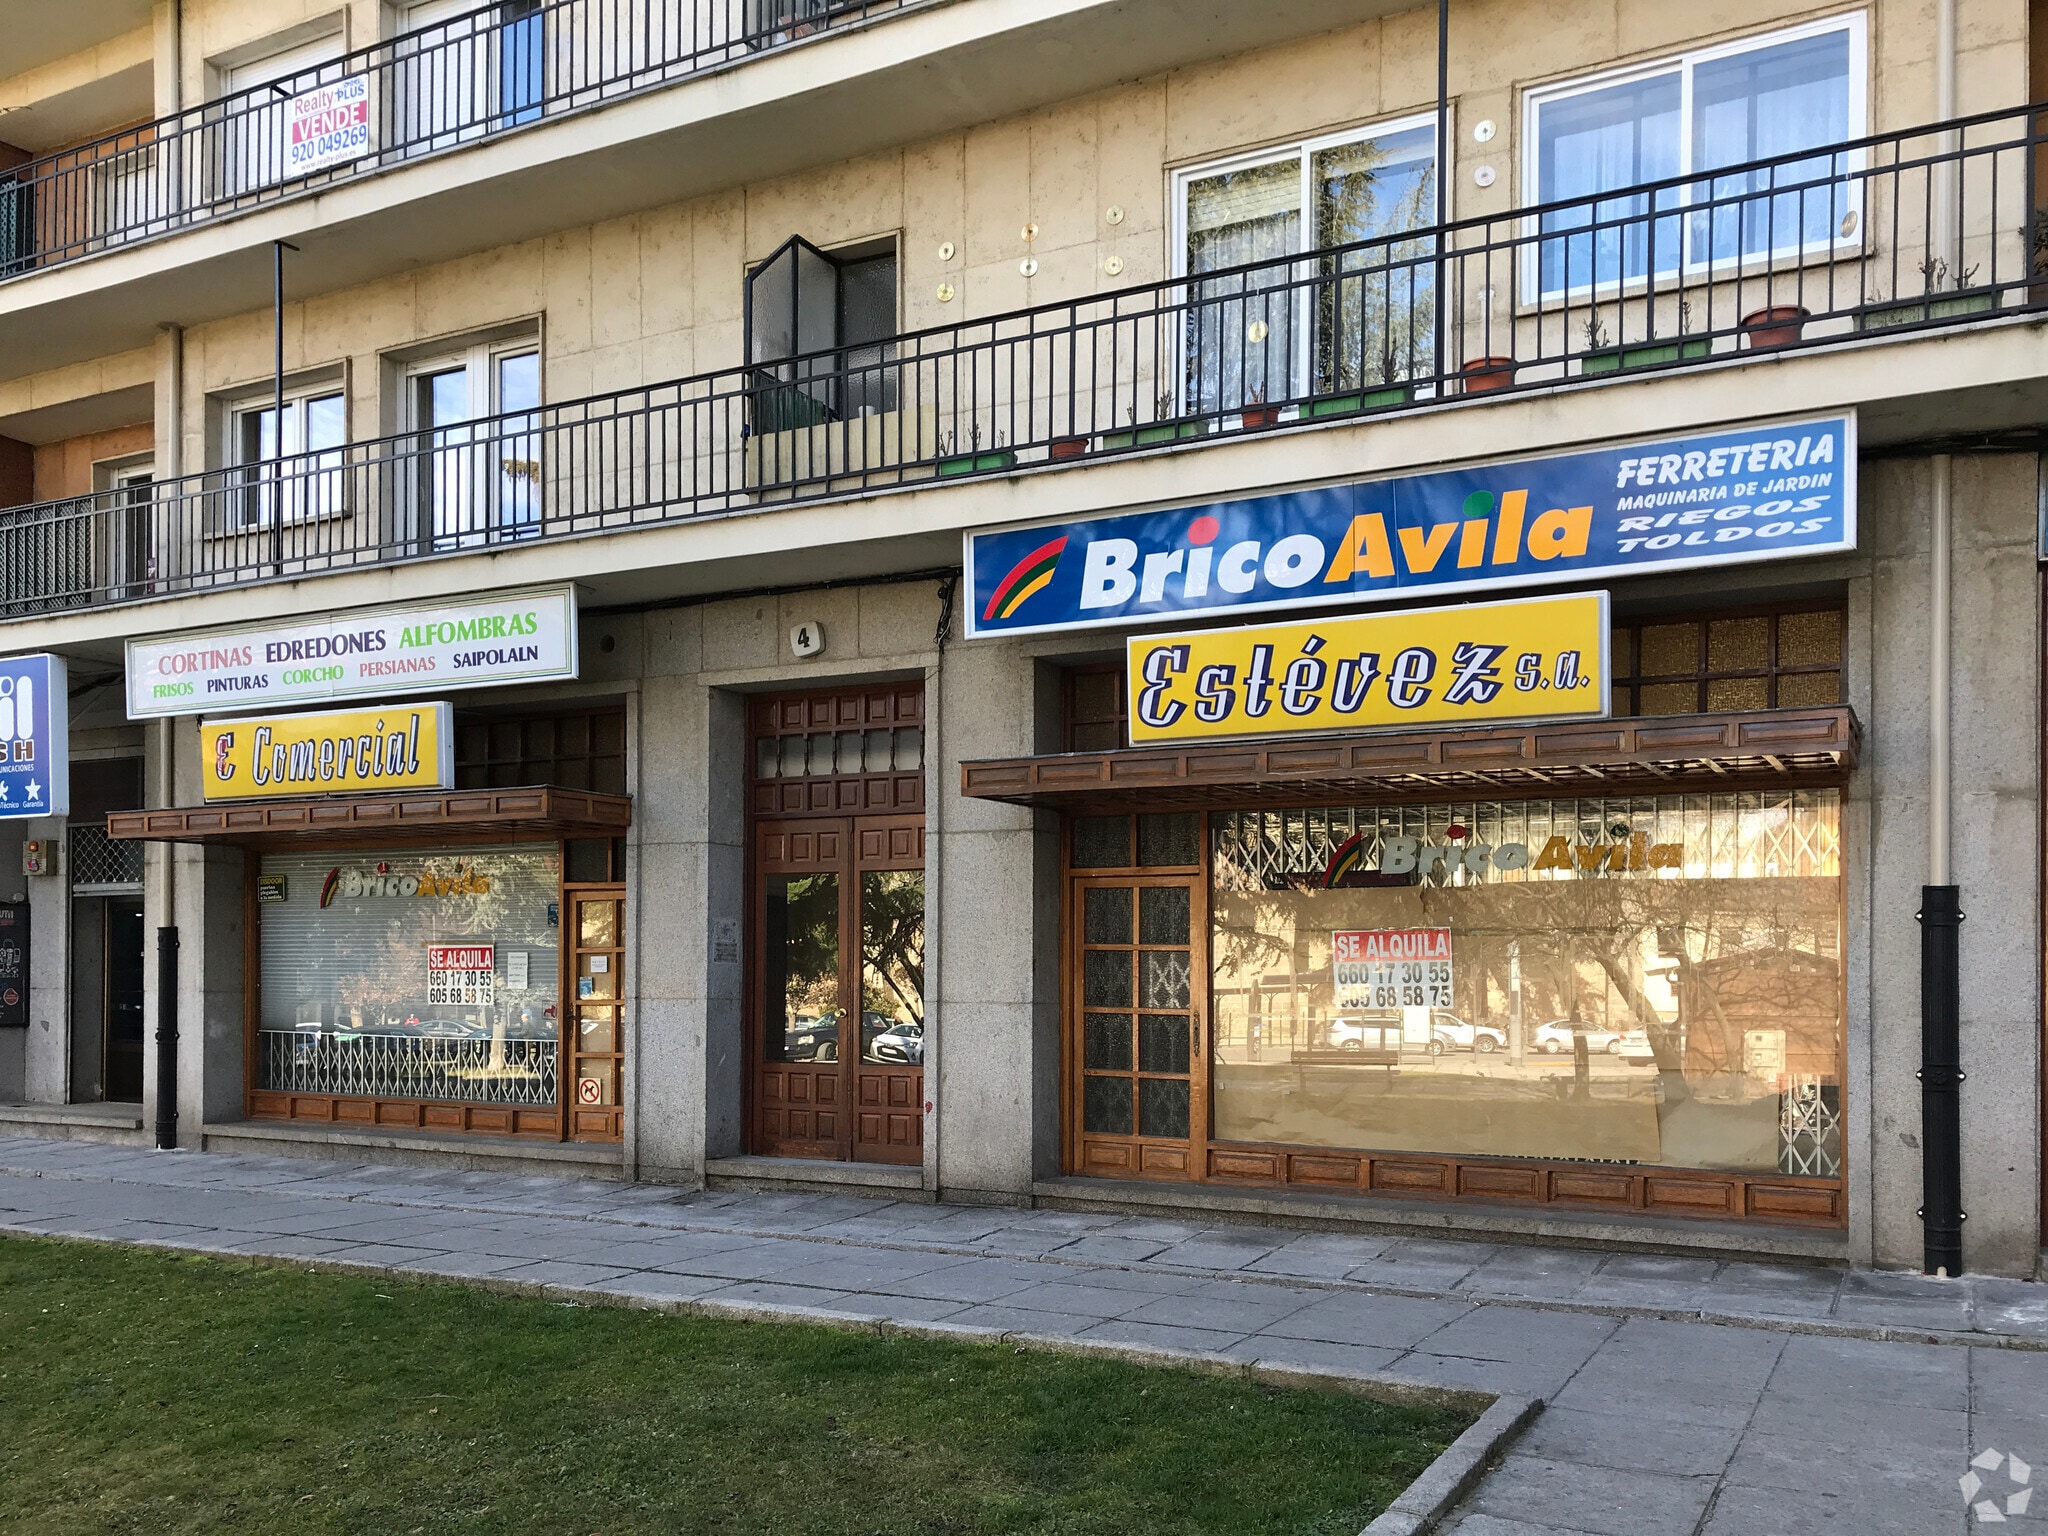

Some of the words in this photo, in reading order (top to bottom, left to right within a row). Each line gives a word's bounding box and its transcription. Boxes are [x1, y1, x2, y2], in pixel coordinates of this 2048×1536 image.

[295, 90, 334, 117] Realty
[298, 102, 360, 141] VENDE
[292, 140, 315, 165] 920
[317, 124, 367, 155] 049269
[1617, 433, 1834, 488] FERRETERIA
[1617, 485, 1728, 511] MAQUINARIA
[1734, 481, 1758, 497] DE
[1762, 473, 1833, 494] JARDIN
[1617, 495, 1832, 532] RIEGOS
[1080, 489, 1594, 610] BricoAvila
[1617, 517, 1833, 553] TOLDOS
[158, 645, 253, 676] CORTINAS
[266, 629, 387, 663] EDREDONES
[399, 612, 538, 649] ALFOMBRAS
[797, 627, 810, 648] 4
[153, 682, 195, 699] FRISOS
[207, 674, 269, 693] PINTURAS
[282, 665, 345, 685] CORCHO
[359, 656, 436, 678] PERSIANAS
[453, 645, 539, 669] SAIPOLALN
[1137, 634, 1508, 728] Estévez
[252, 713, 420, 786] Comercial
[344, 862, 490, 898] BricoAvila
[430, 950, 444, 968] SE
[446, 950, 492, 968] ALQUILA
[1337, 936, 1360, 958] SE
[1366, 933, 1449, 958] ALQUILA
[430, 971, 447, 986] 660
[451, 971, 462, 986] 17
[465, 971, 477, 986] 30
[480, 971, 492, 986] 55
[1338, 963, 1369, 984] 660
[1376, 963, 1395, 983] 17
[1401, 962, 1423, 983] 30
[1428, 962, 1450, 982] 55
[430, 988, 447, 1003] 605
[450, 988, 462, 1003] 68
[465, 988, 477, 1003] 58
[480, 988, 492, 1003] 75
[1375, 986, 1397, 1007] 68
[1402, 986, 1424, 1007] 58
[1429, 985, 1451, 1007] 75
